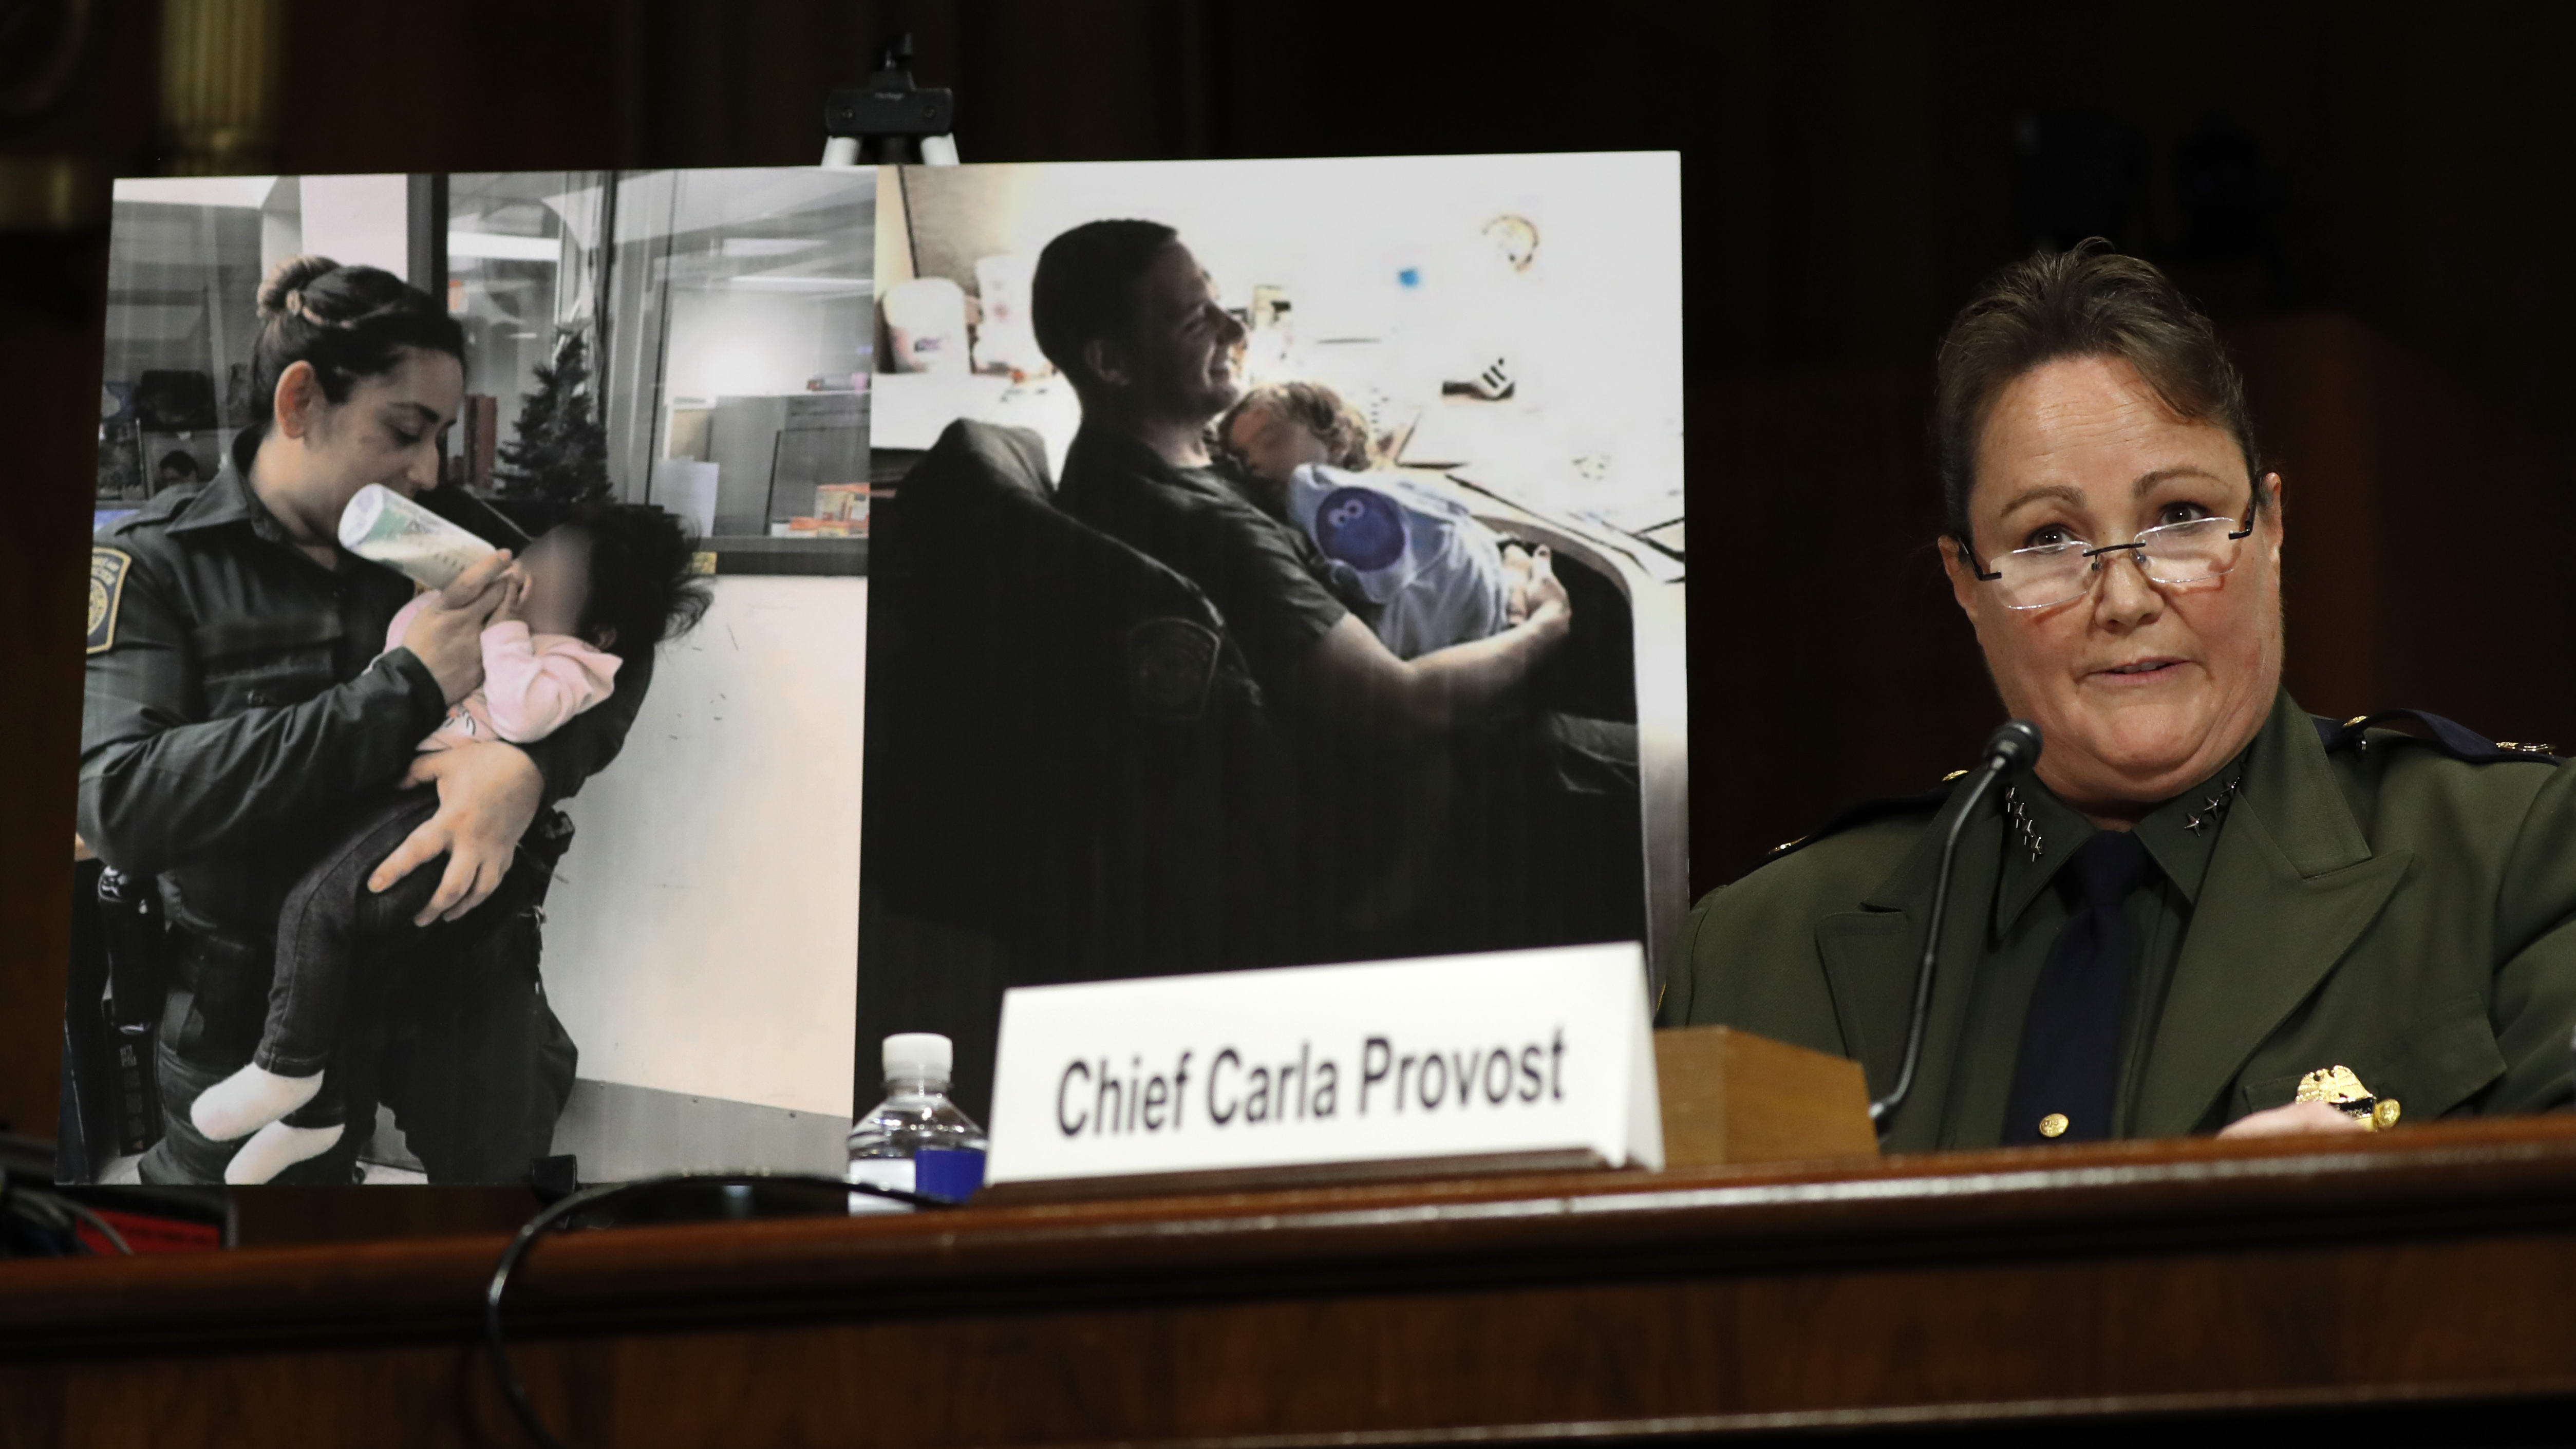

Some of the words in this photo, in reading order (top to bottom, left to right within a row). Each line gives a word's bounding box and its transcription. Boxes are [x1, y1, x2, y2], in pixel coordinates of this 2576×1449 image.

[1056, 1049, 1194, 1138] Chief
[1206, 1041, 1339, 1127] Carla
[1358, 1026, 1566, 1115] Provost
